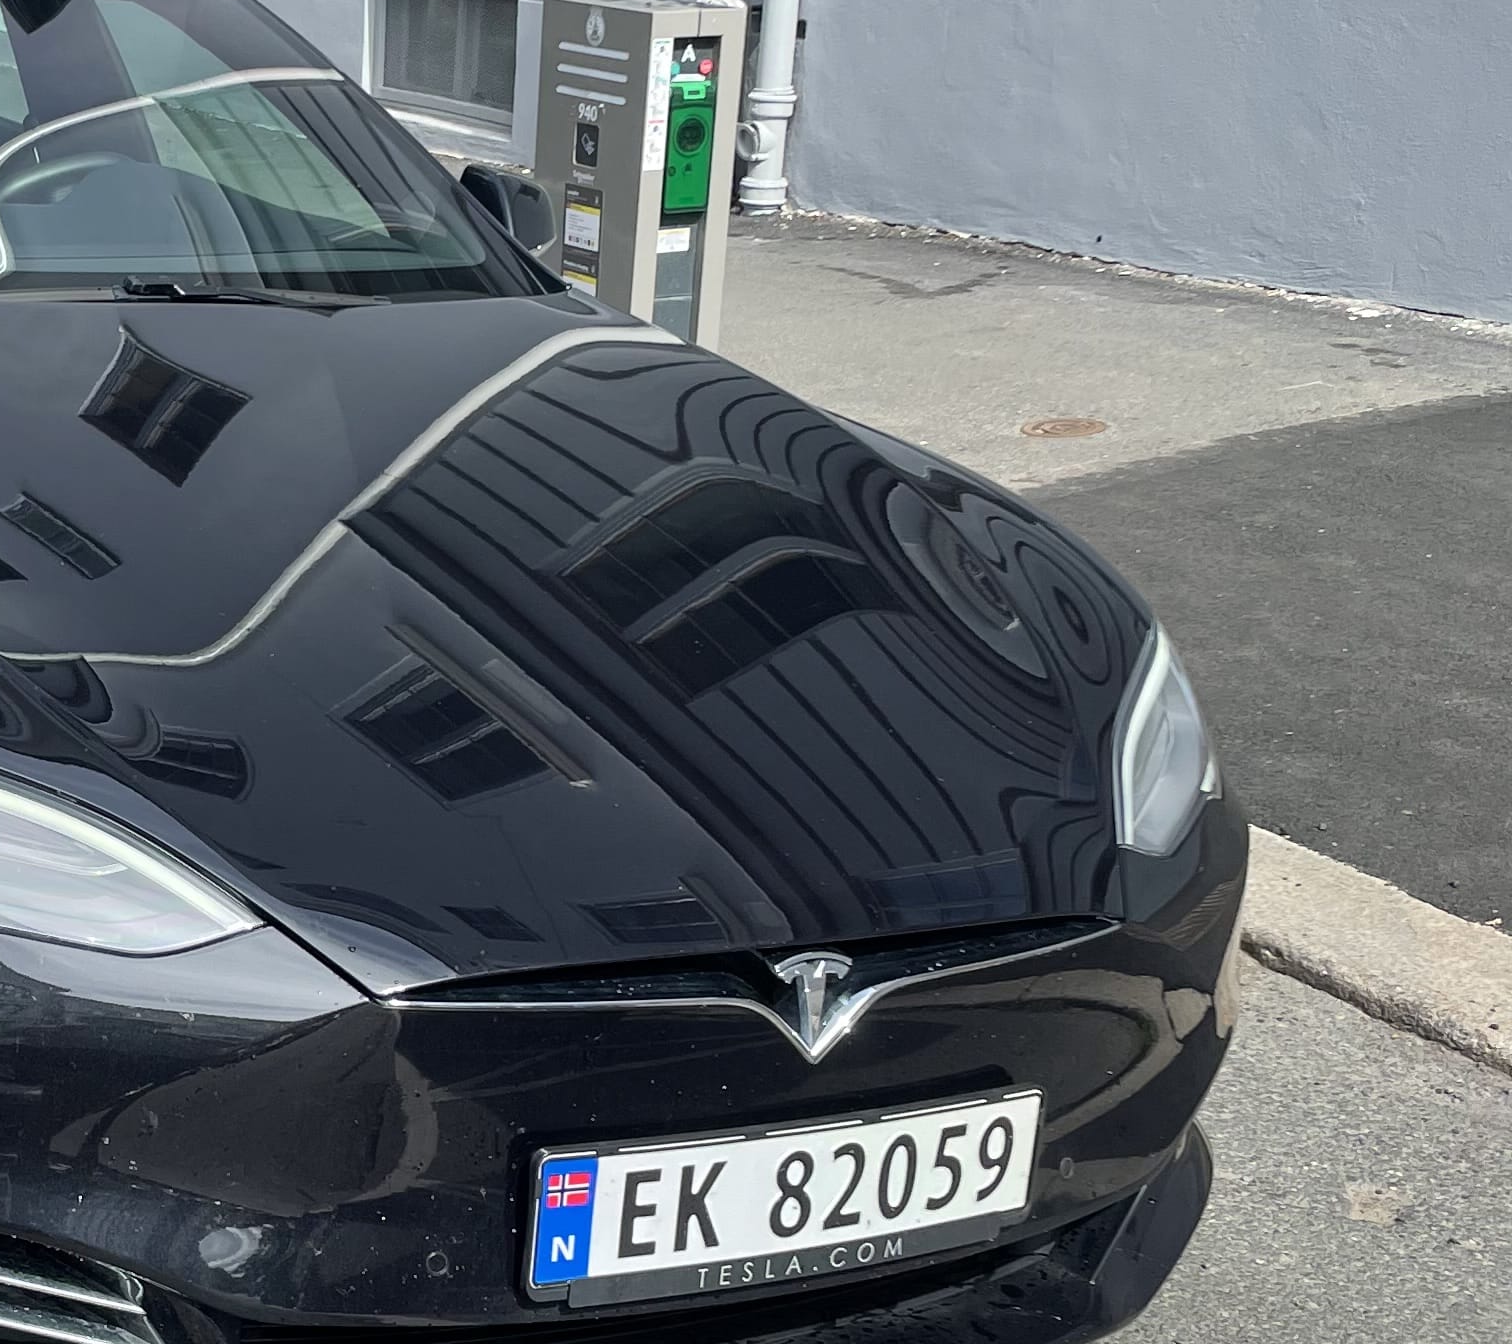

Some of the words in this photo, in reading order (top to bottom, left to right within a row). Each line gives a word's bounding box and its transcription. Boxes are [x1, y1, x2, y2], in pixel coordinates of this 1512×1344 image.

[681, 43, 696, 63] A
[578, 102, 598, 122] 940
[617, 1160, 729, 1259] EK
[769, 1115, 1015, 1239] 82059
[550, 1234, 576, 1263] N
[697, 1237, 903, 1289] TESLA.COM
